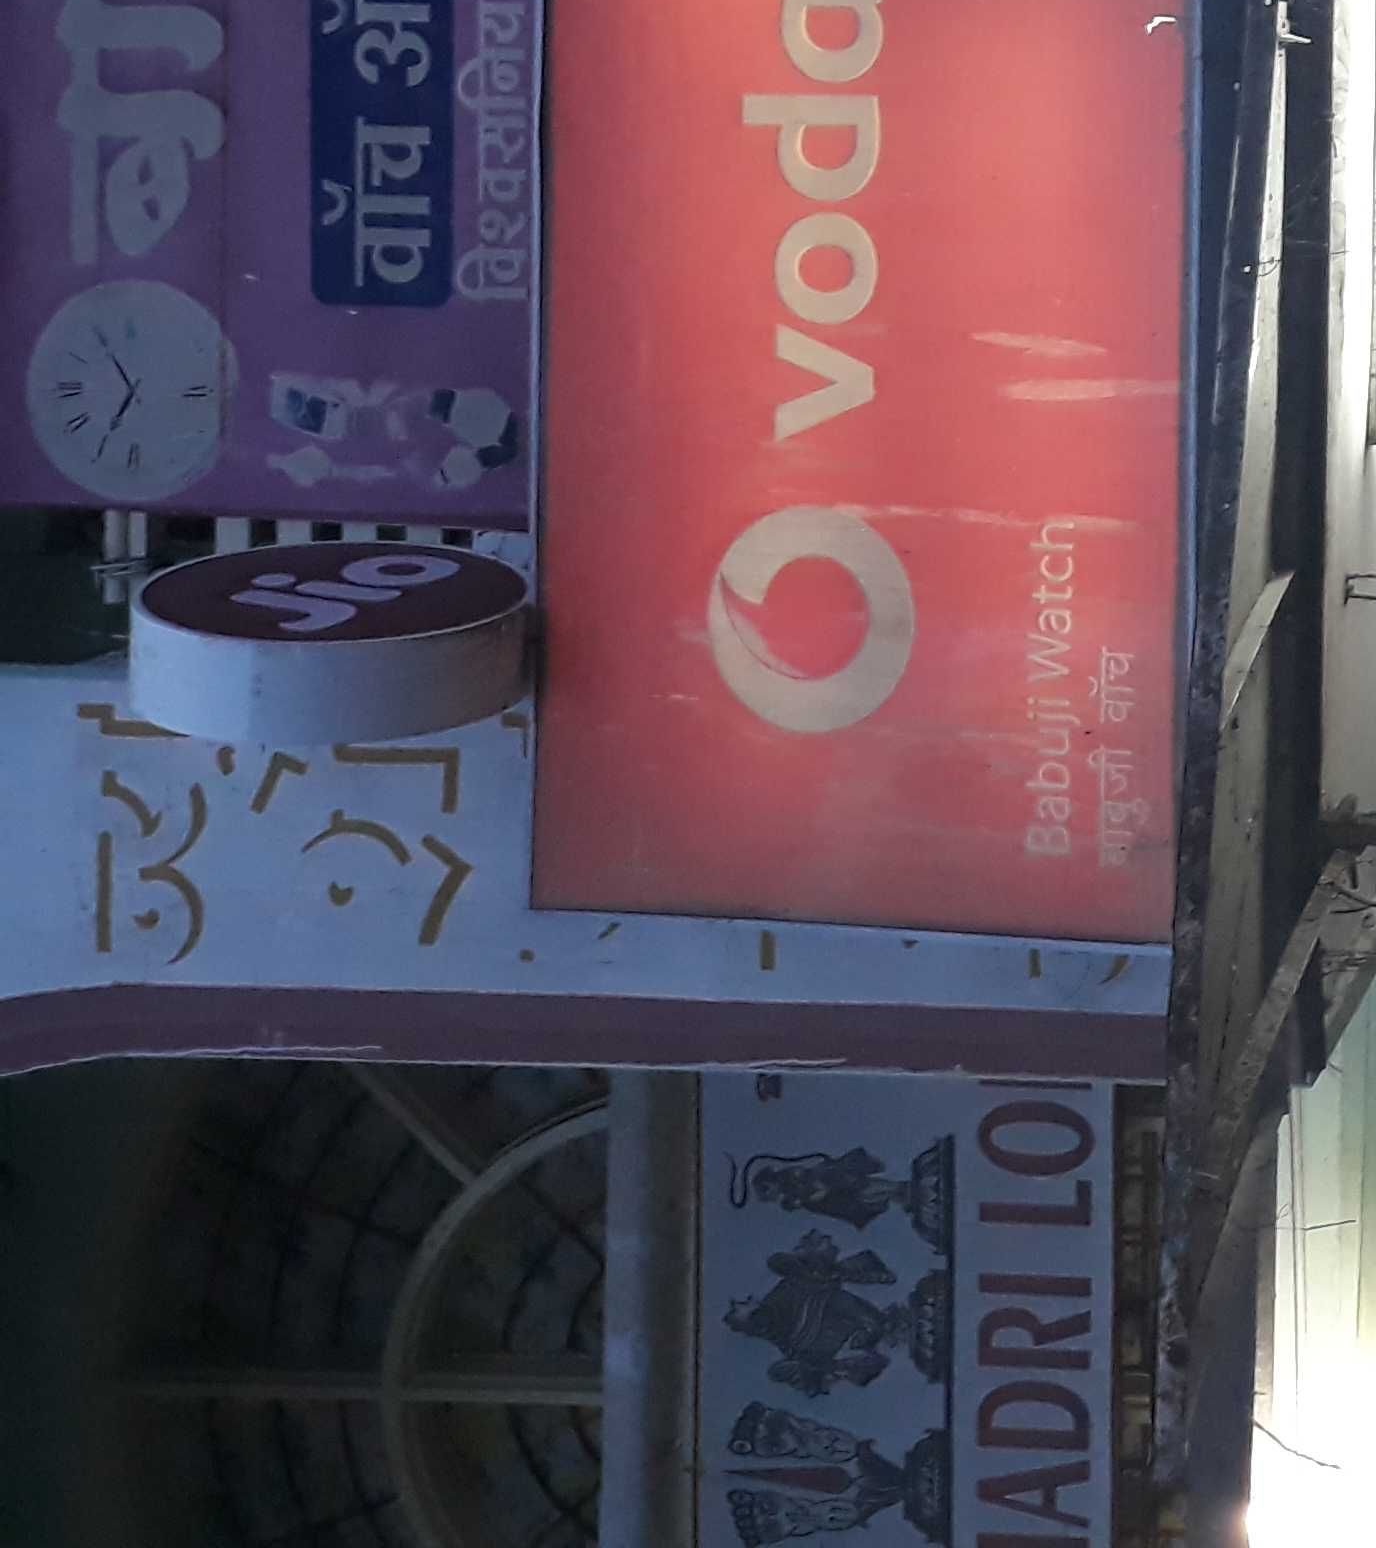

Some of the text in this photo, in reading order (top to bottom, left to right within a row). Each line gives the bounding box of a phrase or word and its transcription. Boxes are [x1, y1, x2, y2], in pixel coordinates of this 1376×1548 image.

[321, 113, 432, 285] वॉच
[228, 553, 460, 633] Jio
[1025, 519, 1080, 857] Babuji Watch
[1088, 646, 1151, 866] बाबुजी वॉच
[975, 1079, 1094, 1227] LO
